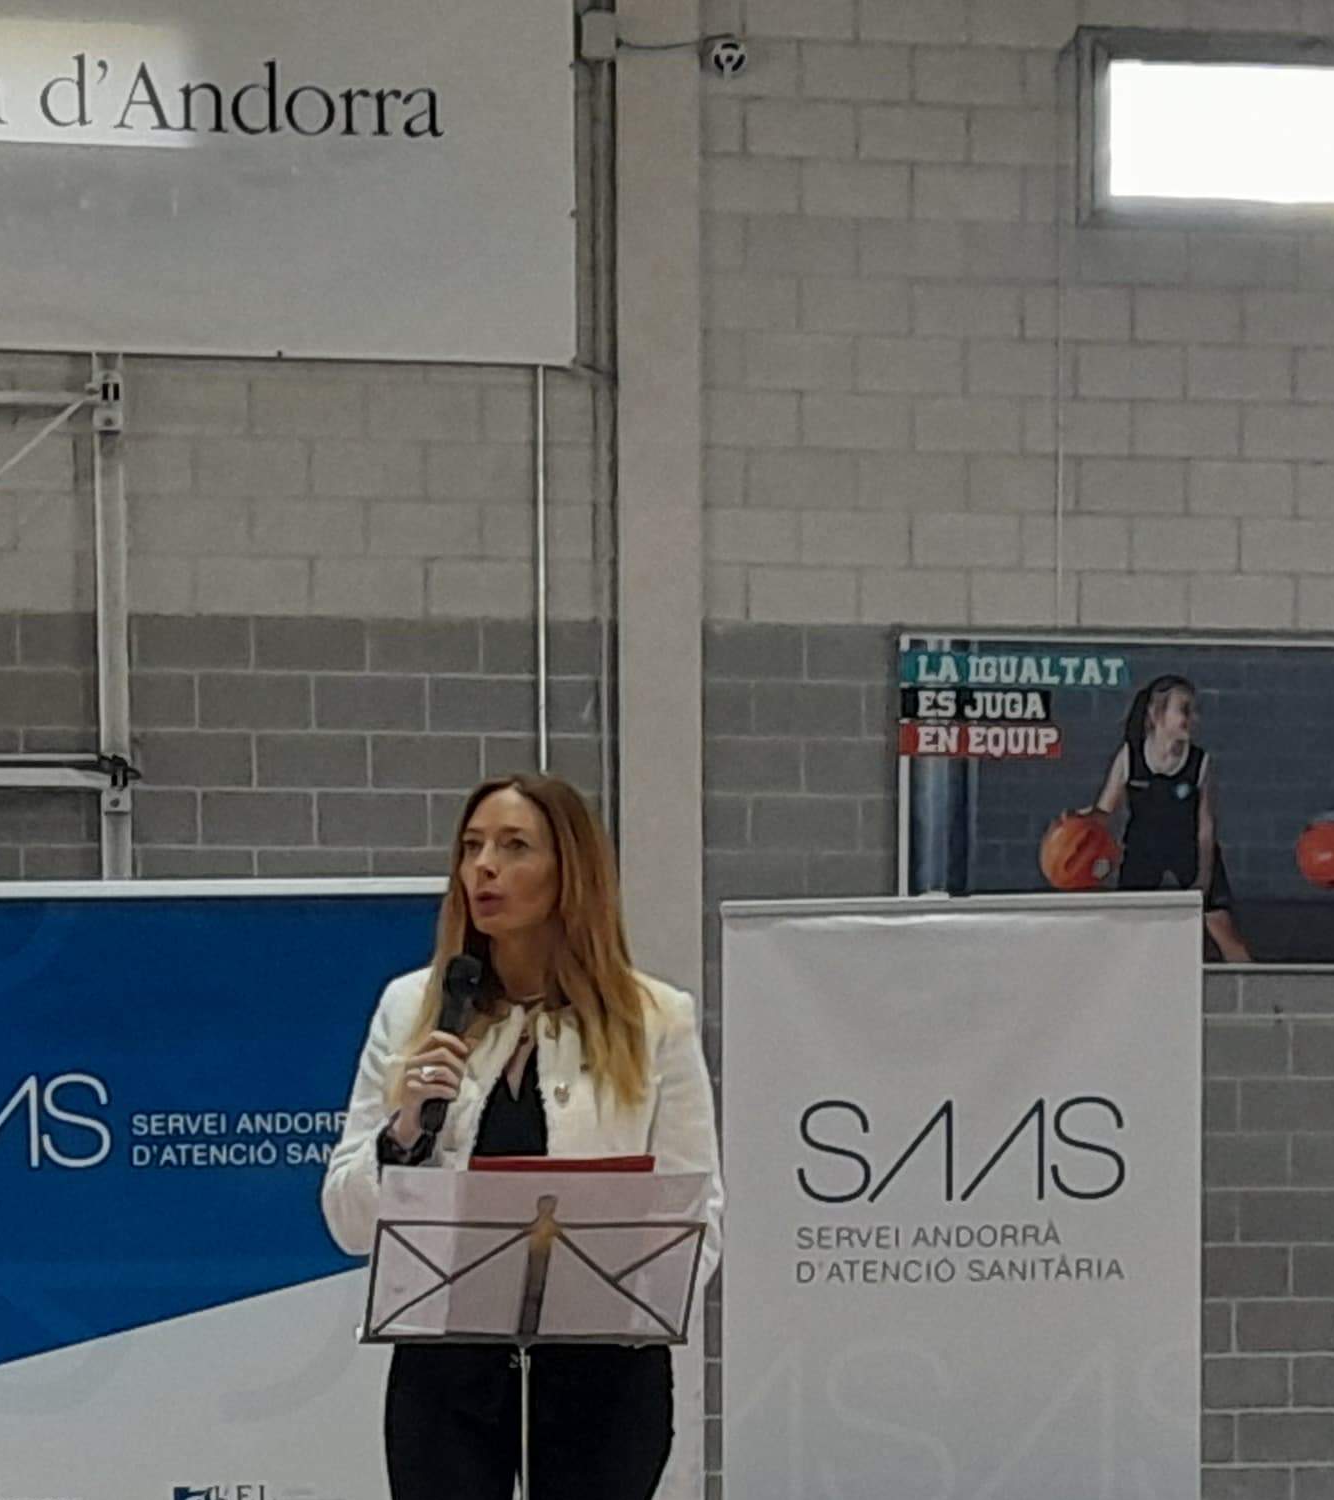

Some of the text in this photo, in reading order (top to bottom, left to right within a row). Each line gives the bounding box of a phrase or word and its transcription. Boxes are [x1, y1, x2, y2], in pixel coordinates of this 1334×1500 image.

[40, 52, 444, 138] d'Andorra
[917, 654, 1125, 686] LA IGUALTAT
[917, 690, 1047, 720] ES JUGA
[917, 725, 1059, 756] EN EQUIP
[131, 1113, 226, 1136] SERVEI
[131, 1139, 277, 1167] D'ATENCIÓ
[796, 1218, 1061, 1250] SERVEI ANDORRÀ
[796, 1252, 1126, 1283] D'ATENCIÓ SANITÀRIA
